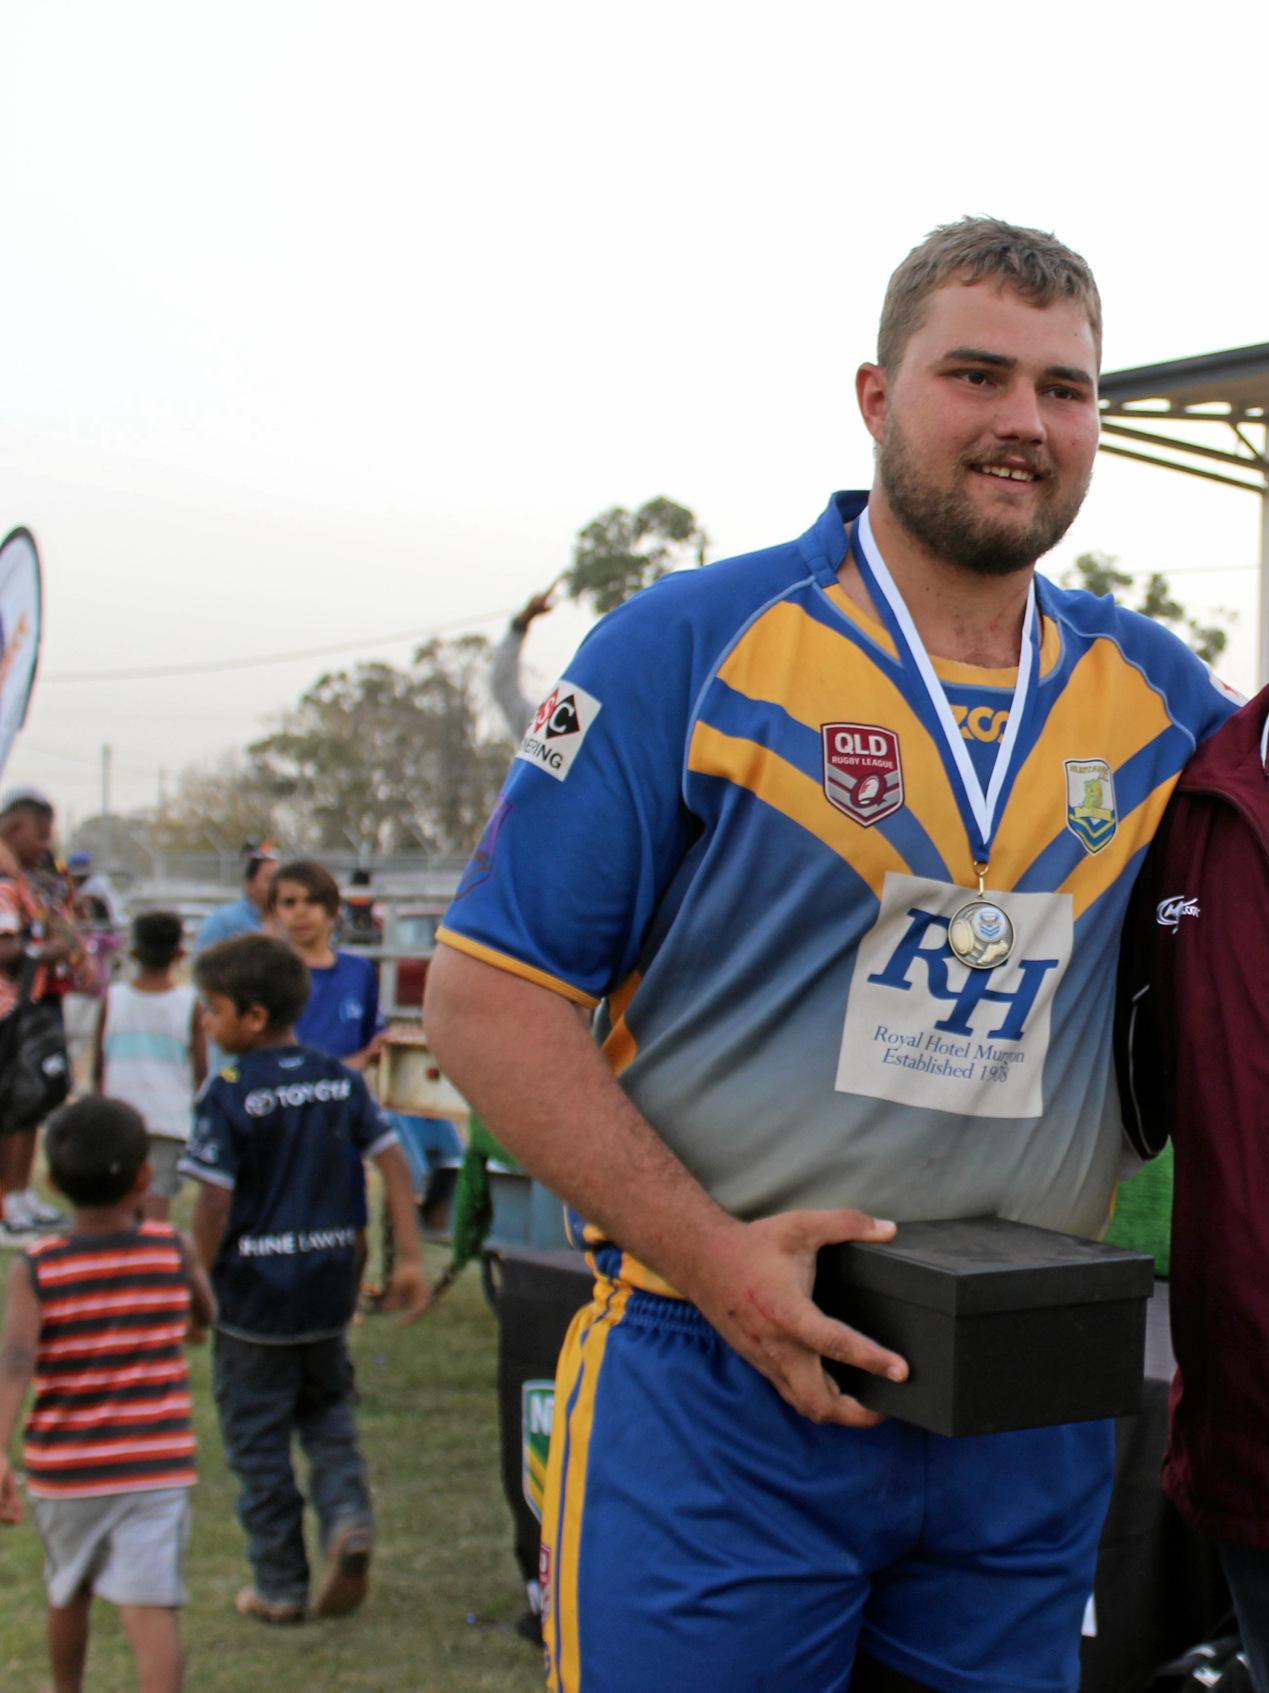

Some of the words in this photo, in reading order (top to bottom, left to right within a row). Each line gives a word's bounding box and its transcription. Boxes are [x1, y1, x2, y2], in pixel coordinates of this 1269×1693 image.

[834, 731, 888, 757] QLD
[831, 756, 861, 766] RUGBY
[861, 757, 895, 770] LEAGUE
[867, 908, 1060, 1041] RH
[873, 1025, 924, 1050] Royal
[925, 1035, 971, 1058] Hotel
[881, 1047, 975, 1080] Established
